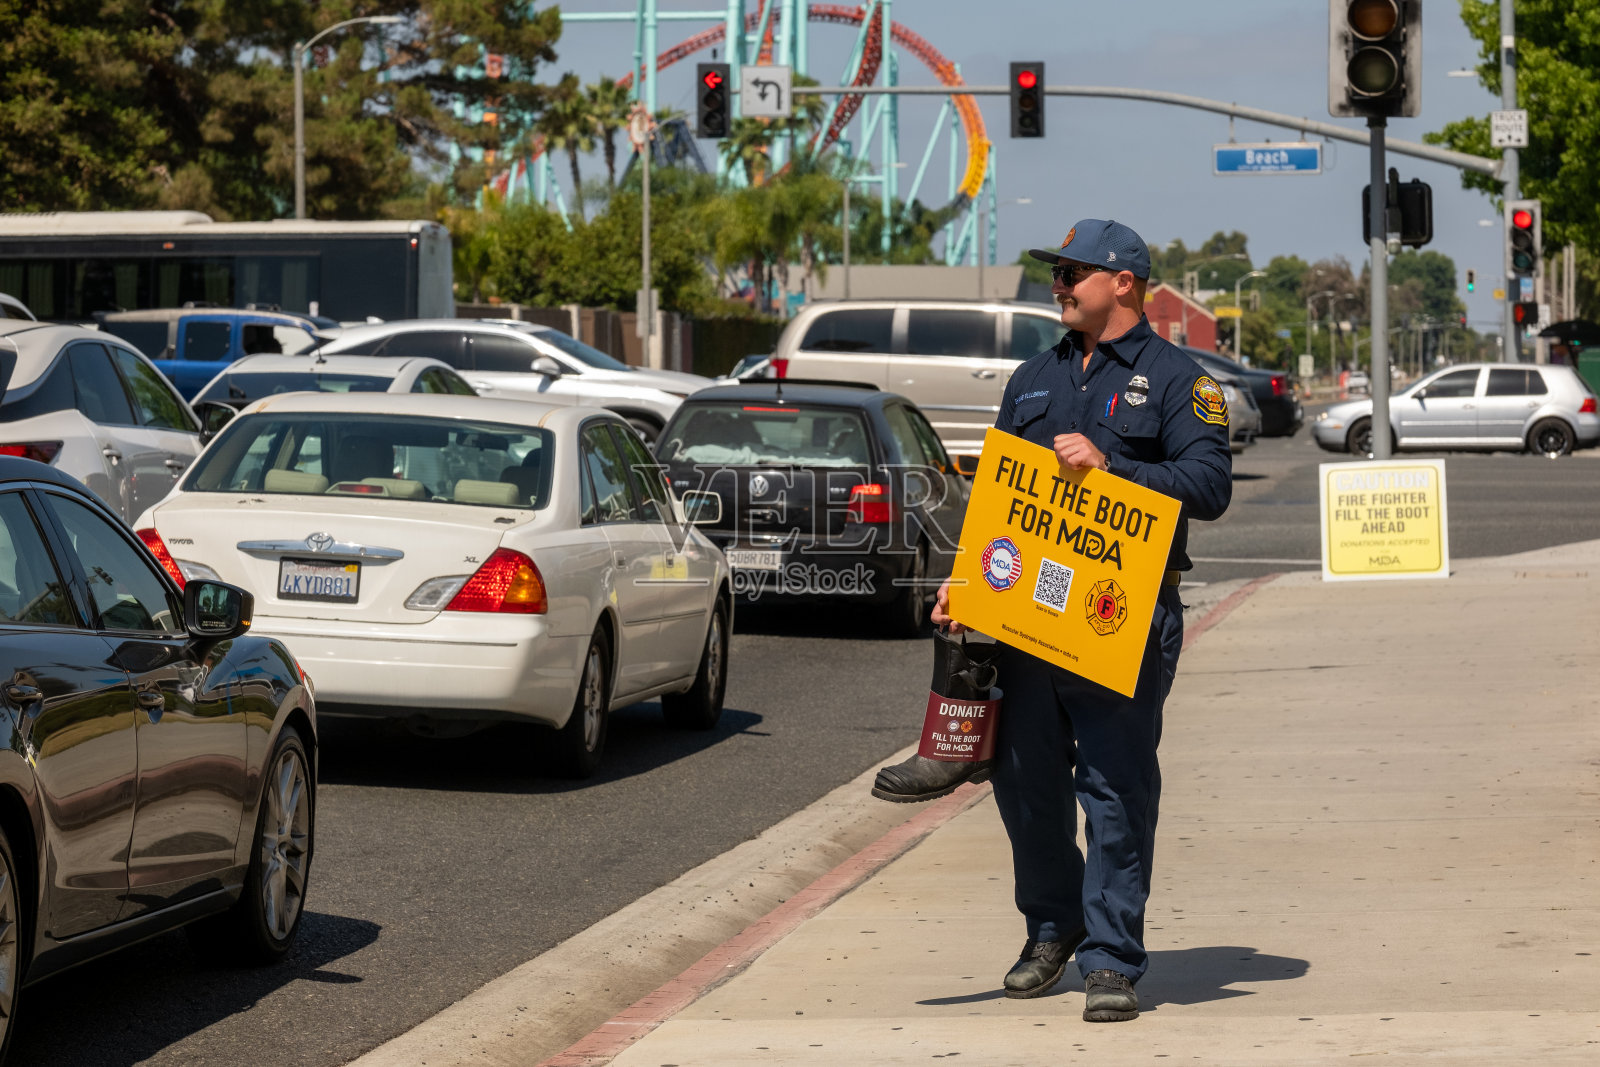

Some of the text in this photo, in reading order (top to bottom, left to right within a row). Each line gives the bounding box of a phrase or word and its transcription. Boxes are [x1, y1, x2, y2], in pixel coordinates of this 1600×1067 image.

[1494, 112, 1523, 121] TRUCK
[1495, 123, 1523, 132] ROUTE
[1245, 149, 1289, 165] Beach
[1336, 471, 1429, 491] CAUTION
[995, 455, 1159, 543] FILL THE BOOT
[1338, 492, 1427, 506] FIRE FIGHTER
[1335, 506, 1430, 521] FILL THE BOOT
[1007, 498, 1122, 571] FOR MDA
[1361, 521, 1405, 534] AHEAD
[1340, 538, 1430, 548] DONATIONS ACCEPTED
[991, 557, 1011, 572] MDA
[1369, 555, 1401, 566] MDA
[283, 574, 352, 597] 4KYD881
[1101, 599, 1113, 614] F
[1117, 606, 1126, 619] F
[939, 702, 986, 718] DONATE
[931, 732, 981, 743] FILL THE BOOT
[936, 742, 973, 752] FOR MDA
